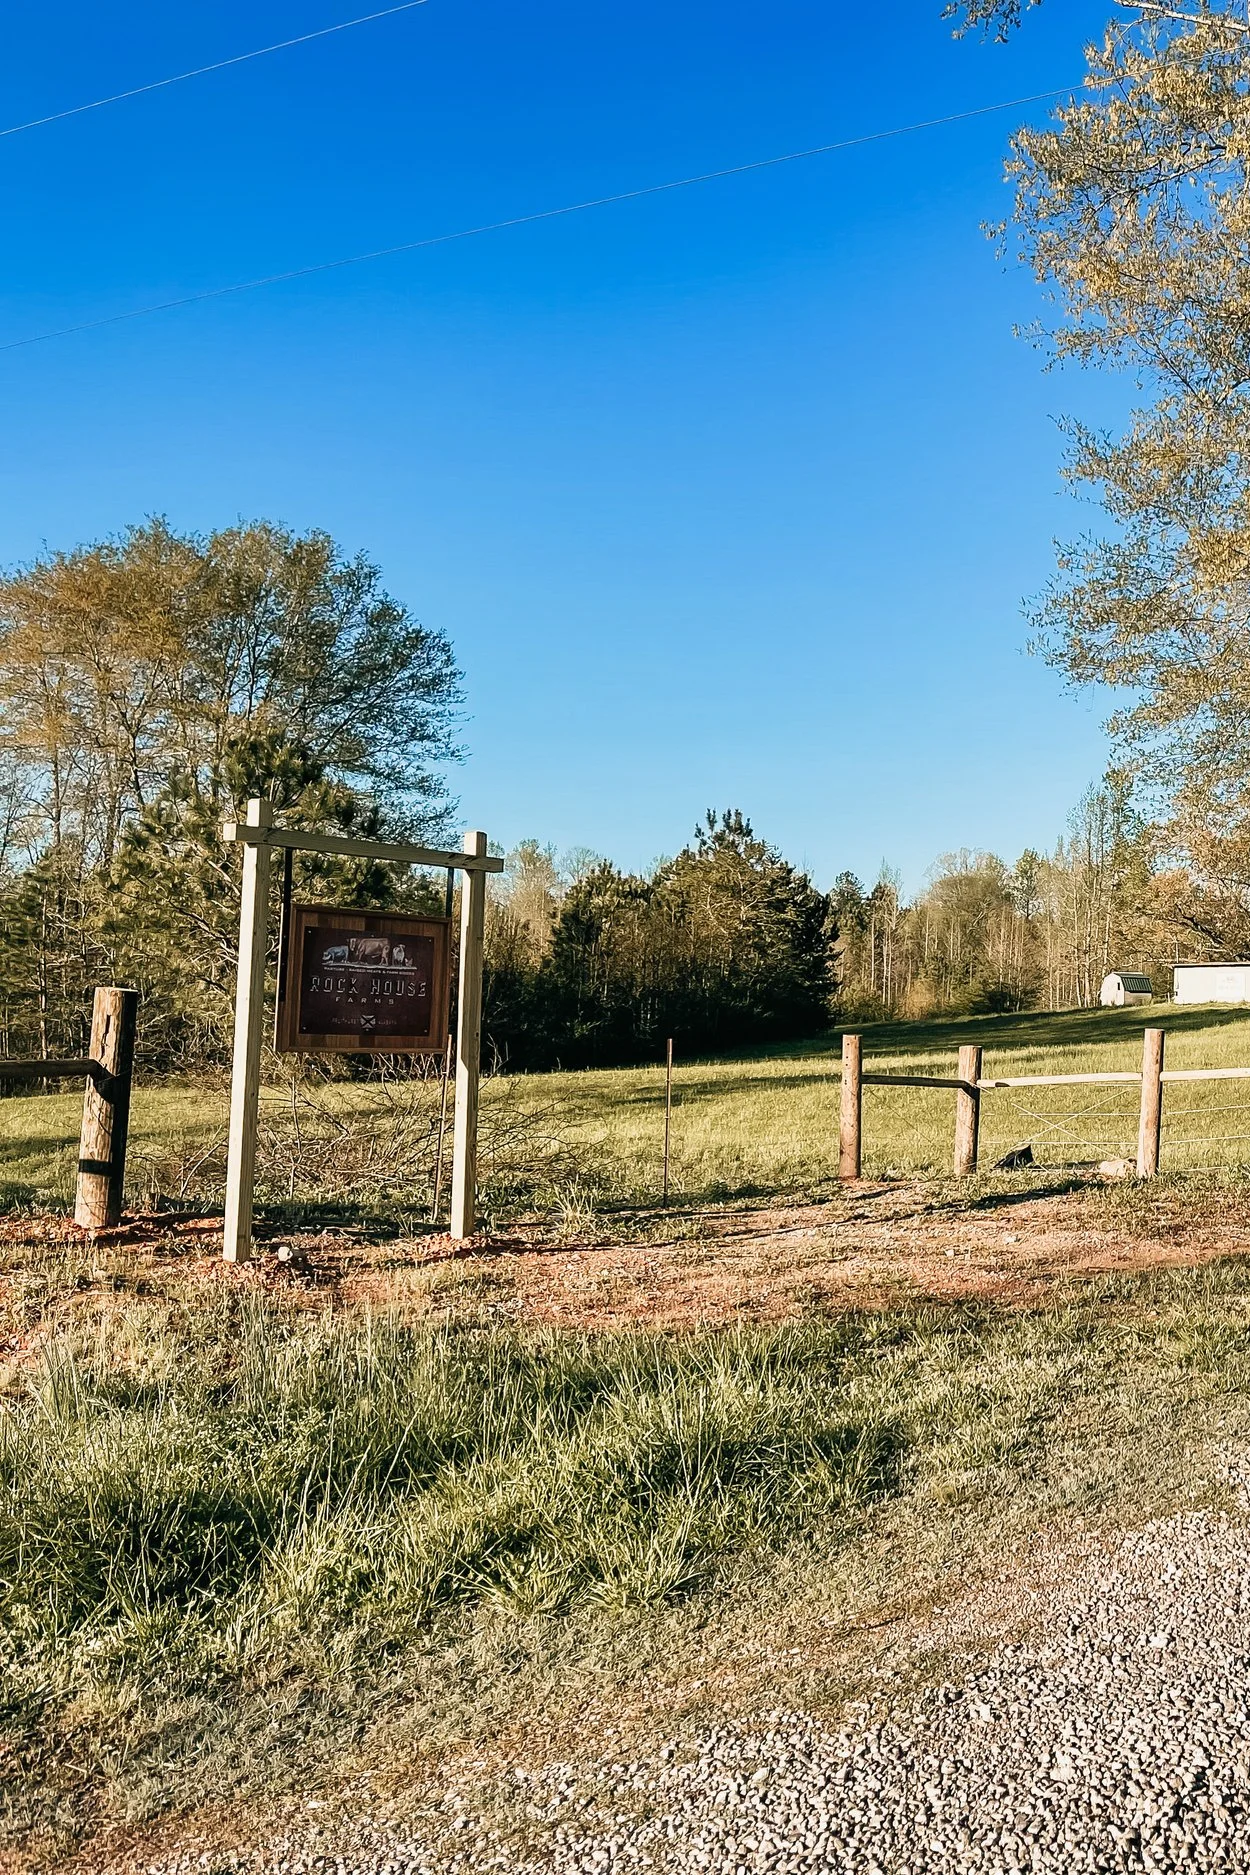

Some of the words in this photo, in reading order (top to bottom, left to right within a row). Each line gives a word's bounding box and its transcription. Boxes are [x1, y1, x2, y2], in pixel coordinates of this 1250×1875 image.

[310, 976, 359, 994] ROCK
[370, 979, 427, 997] HOUSE
[335, 996, 394, 1005] FARMS
